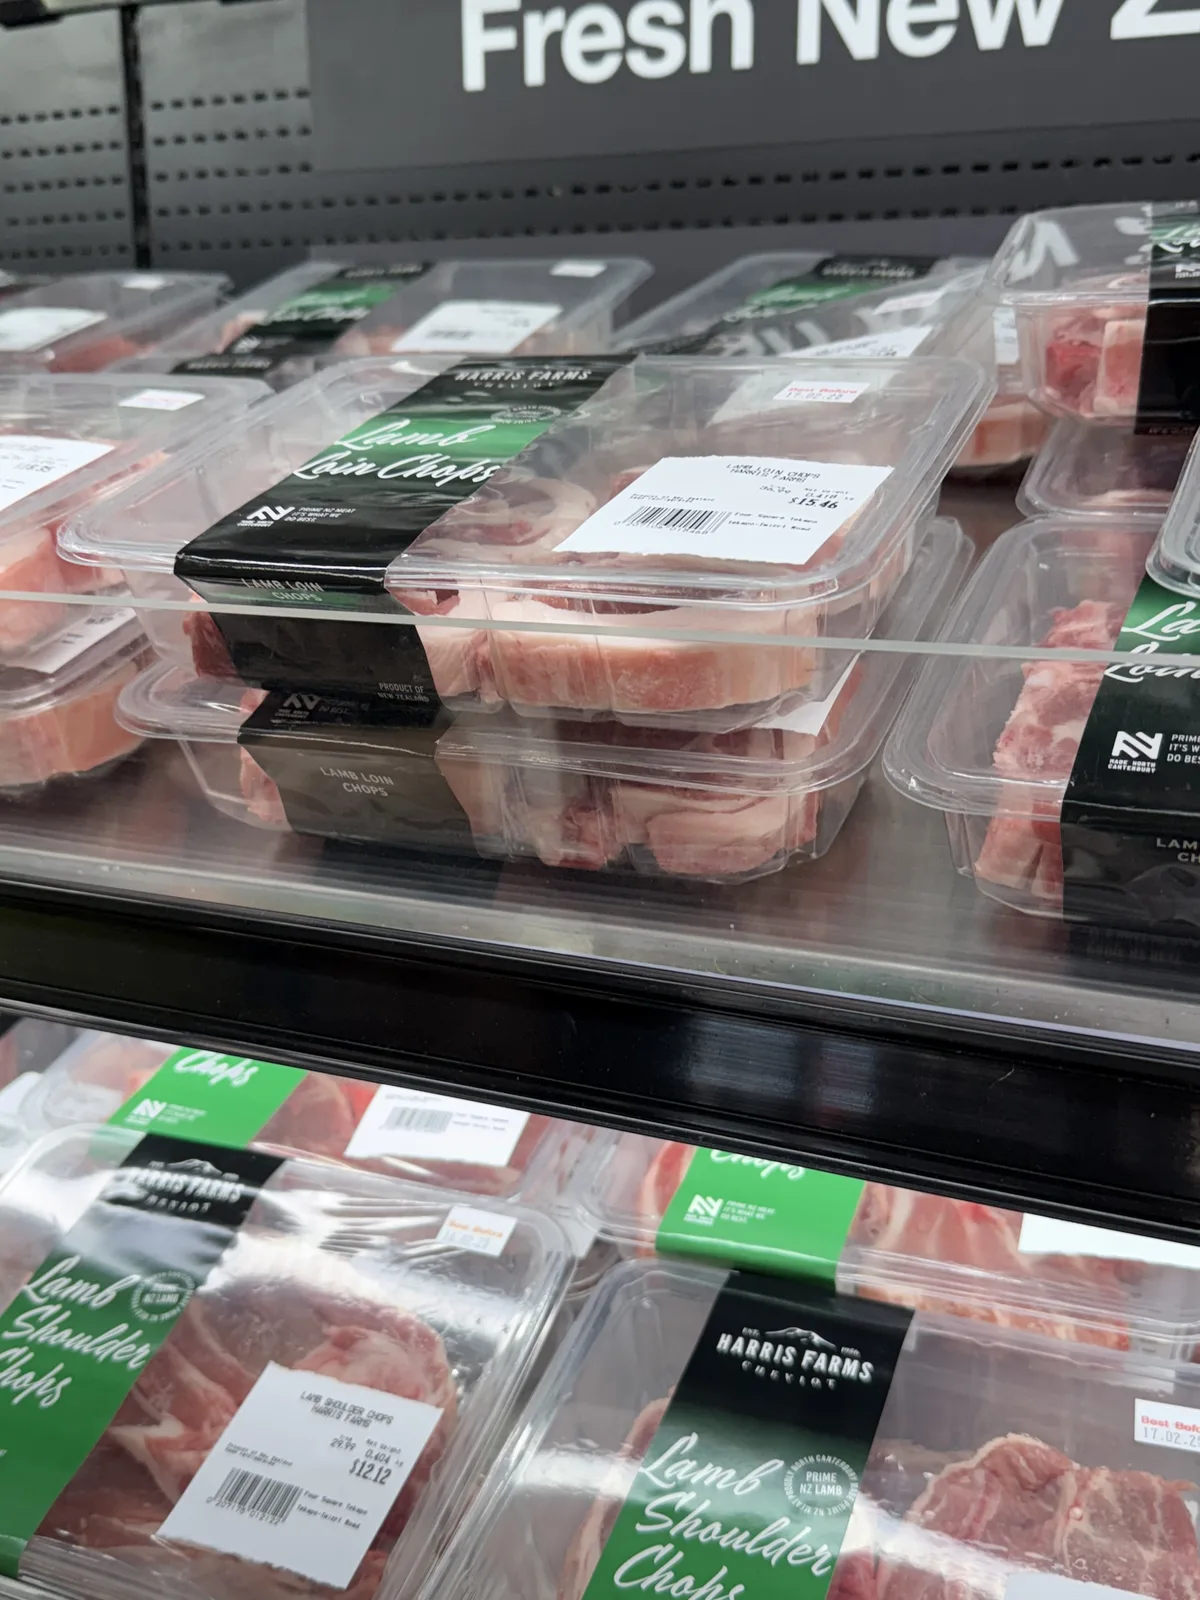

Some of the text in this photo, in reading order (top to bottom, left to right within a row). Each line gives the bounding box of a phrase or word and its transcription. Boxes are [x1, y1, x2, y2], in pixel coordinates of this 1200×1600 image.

[461, 0, 755, 92] Fresh
[796, 0, 1064, 65] New
[454, 369, 592, 381] HARRIS FARMS
[333, 418, 497, 451] Lamb
[292, 450, 502, 488] Loin Chops
[730, 468, 807, 483] HARRIS FARMS
[756, 466, 784, 476] LOIN
[787, 471, 821, 480] CHOPS
[788, 497, 839, 510] $15.46
[240, 577, 325, 592] LAMB LOIN
[271, 591, 323, 602] CHOPS
[378, 682, 425, 694] PRODUCT OF
[377, 692, 430, 703] NEW ZEALAND
[1168, 743, 1188, 753] IT'S
[1131, 760, 1156, 768] NORTH
[1166, 753, 1182, 763] DO
[320, 766, 395, 786] LAMB LOIN
[1107, 763, 1157, 774] CANTERBURY
[342, 782, 389, 797] CHOPS
[21, 1254, 142, 1309] Lamb
[1, 1303, 151, 1371] Shoulder
[716, 1332, 875, 1385] HARRIS FARMS
[741, 1359, 837, 1391] CHEVIOT
[300, 1390, 395, 1425] LAMB SHOULDER CHOPS
[310, 1403, 372, 1428] HARRIS FARMS
[1141, 1414, 1169, 1428] Best
[329, 1437, 357, 1452] 29.99
[1143, 1426, 1200, 1448] 17.02.2
[364, 1448, 392, 1465] 0.404
[639, 1431, 785, 1496] Lamb
[791, 1454, 815, 1472] NORTH
[349, 1457, 393, 1486] $12.12
[805, 1471, 838, 1483] PRIME
[799, 1483, 843, 1496] NZ LAMB
[303, 1490, 368, 1516] Four Square Tekapo
[344, 1518, 361, 1530] Road
[635, 1491, 833, 1577] Shoulder
